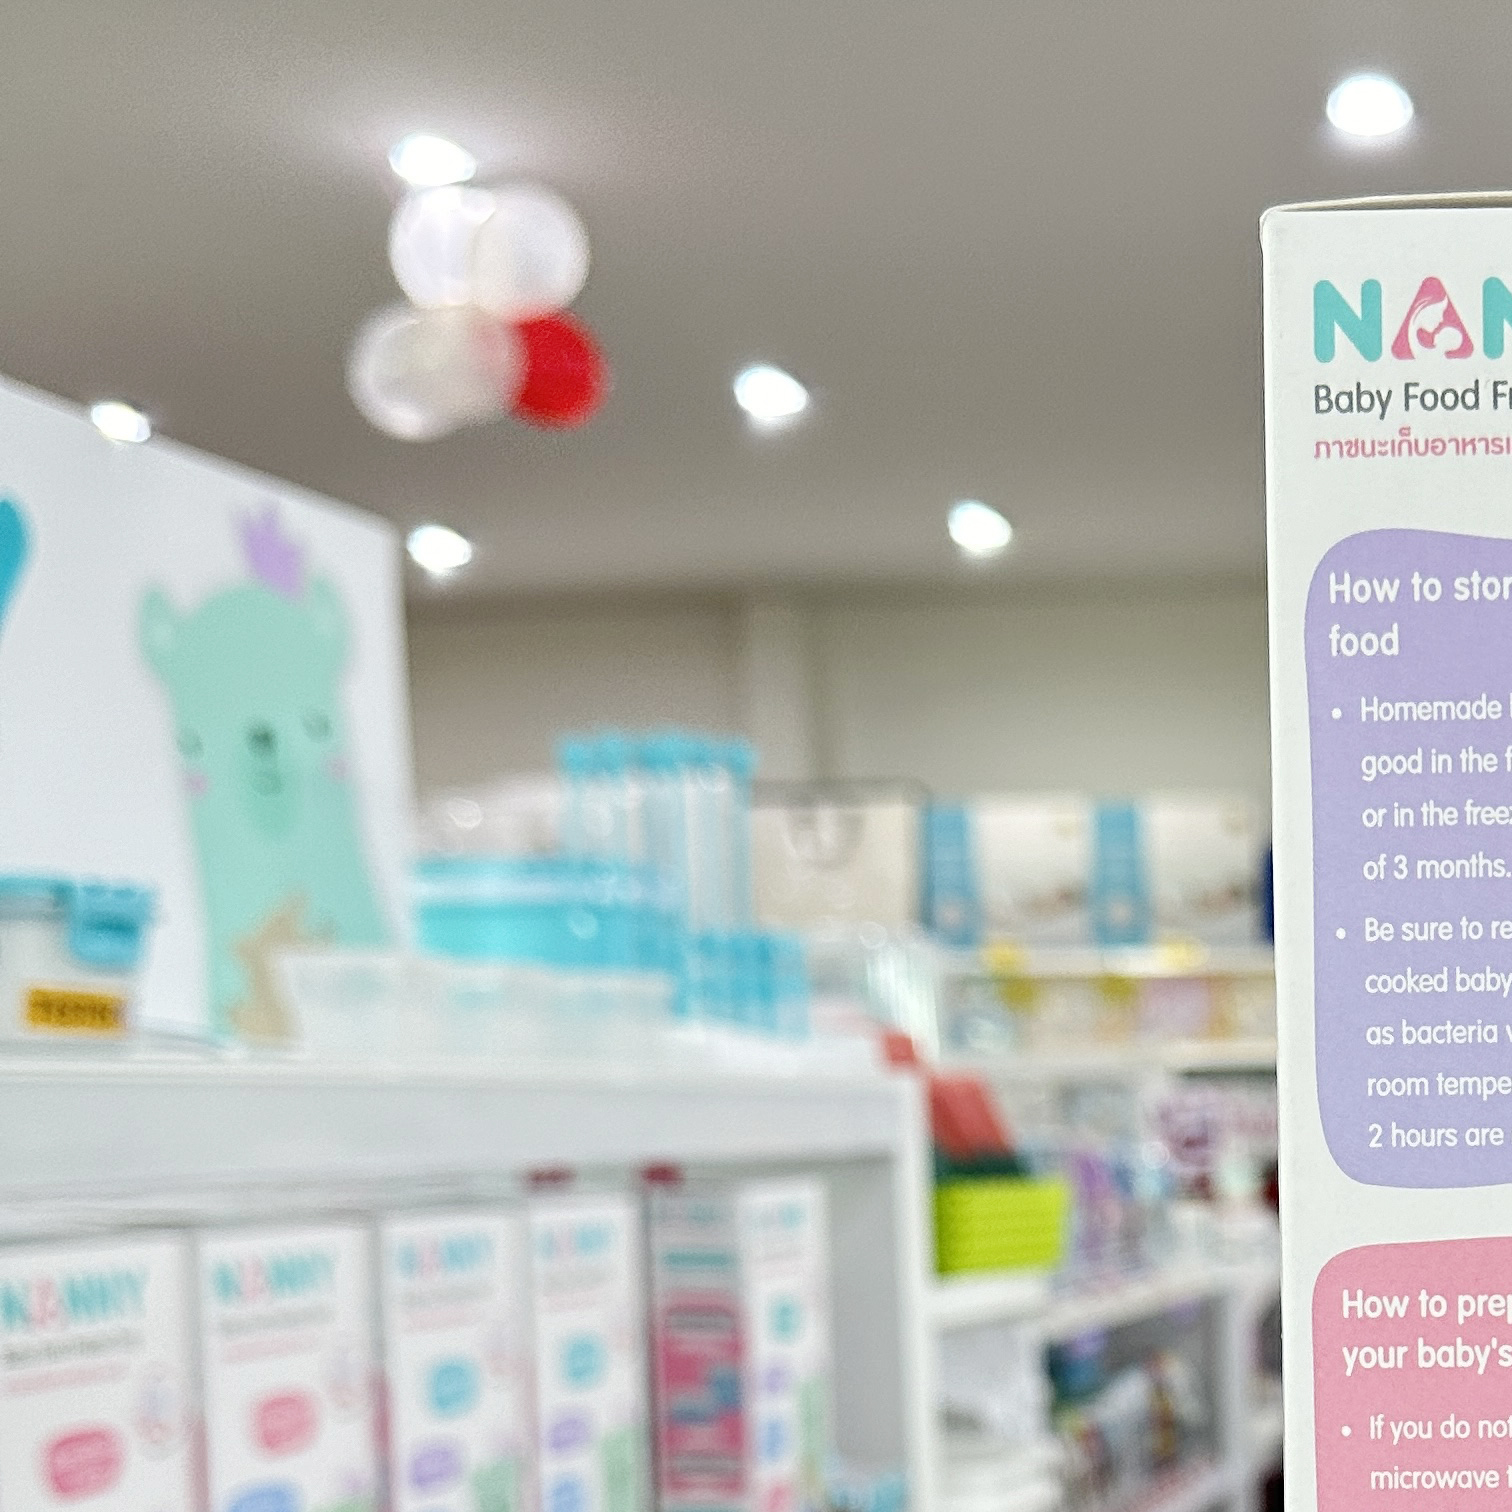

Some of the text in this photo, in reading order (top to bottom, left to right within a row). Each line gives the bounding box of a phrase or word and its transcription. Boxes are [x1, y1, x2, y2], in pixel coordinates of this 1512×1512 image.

[1315, 382, 1392, 420] Baby
[1404, 379, 1479, 411] Food
[1330, 571, 1400, 603] How
[1411, 572, 1442, 601] to
[1329, 623, 1399, 656] food
[1361, 693, 1502, 721] Homemade
[1362, 747, 1422, 782] good
[1432, 749, 1452, 773] in
[1460, 746, 1498, 773] the
[1363, 851, 1511, 880] of 3 months.
[1365, 917, 1394, 941] Be
[1402, 922, 1453, 941] sure
[1460, 916, 1483, 939] to
[1368, 1078, 1428, 1096] room
[1369, 1124, 1382, 1147] 2
[1392, 1122, 1457, 1147] hours
[1465, 1128, 1504, 1146] are
[1343, 1289, 1409, 1318] How
[1418, 1289, 1447, 1317] to
[1342, 1346, 1408, 1376] your
[1418, 1337, 1512, 1374] baby's
[1371, 1466, 1499, 1489] microwave
